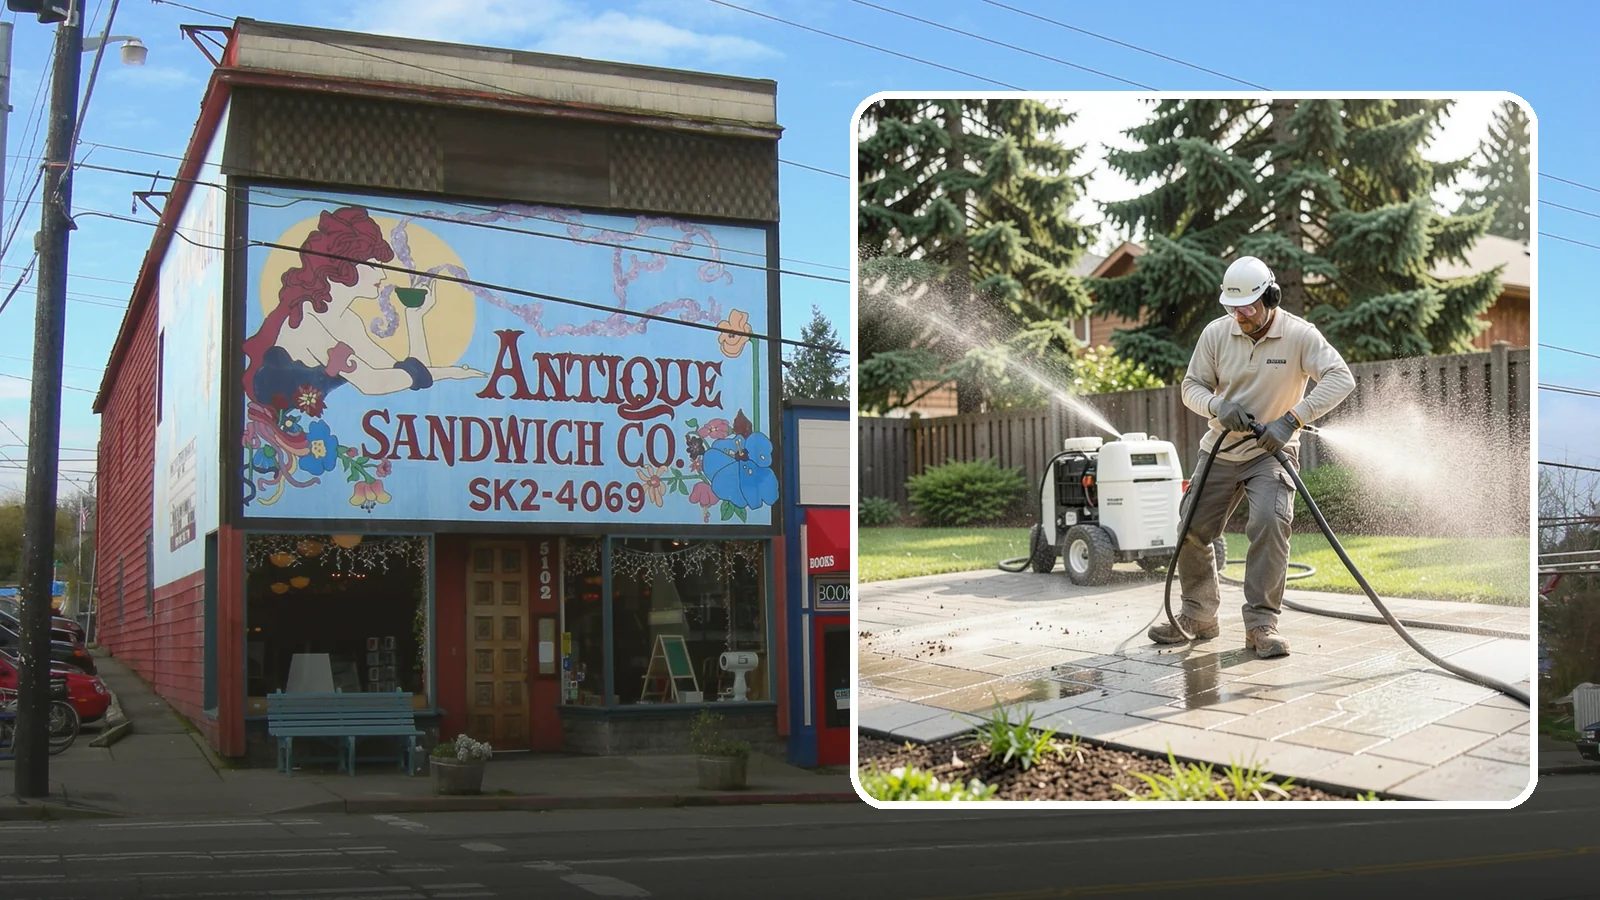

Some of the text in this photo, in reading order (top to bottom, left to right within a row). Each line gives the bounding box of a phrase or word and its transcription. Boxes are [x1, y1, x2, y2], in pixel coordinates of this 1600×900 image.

[476, 329, 724, 421] ANTIQUE
[361, 408, 685, 468] SANDWICH CO.
[468, 477, 646, 514] SK2-4069
[539, 541, 552, 600] 5102
[809, 555, 835, 569] BOOKS
